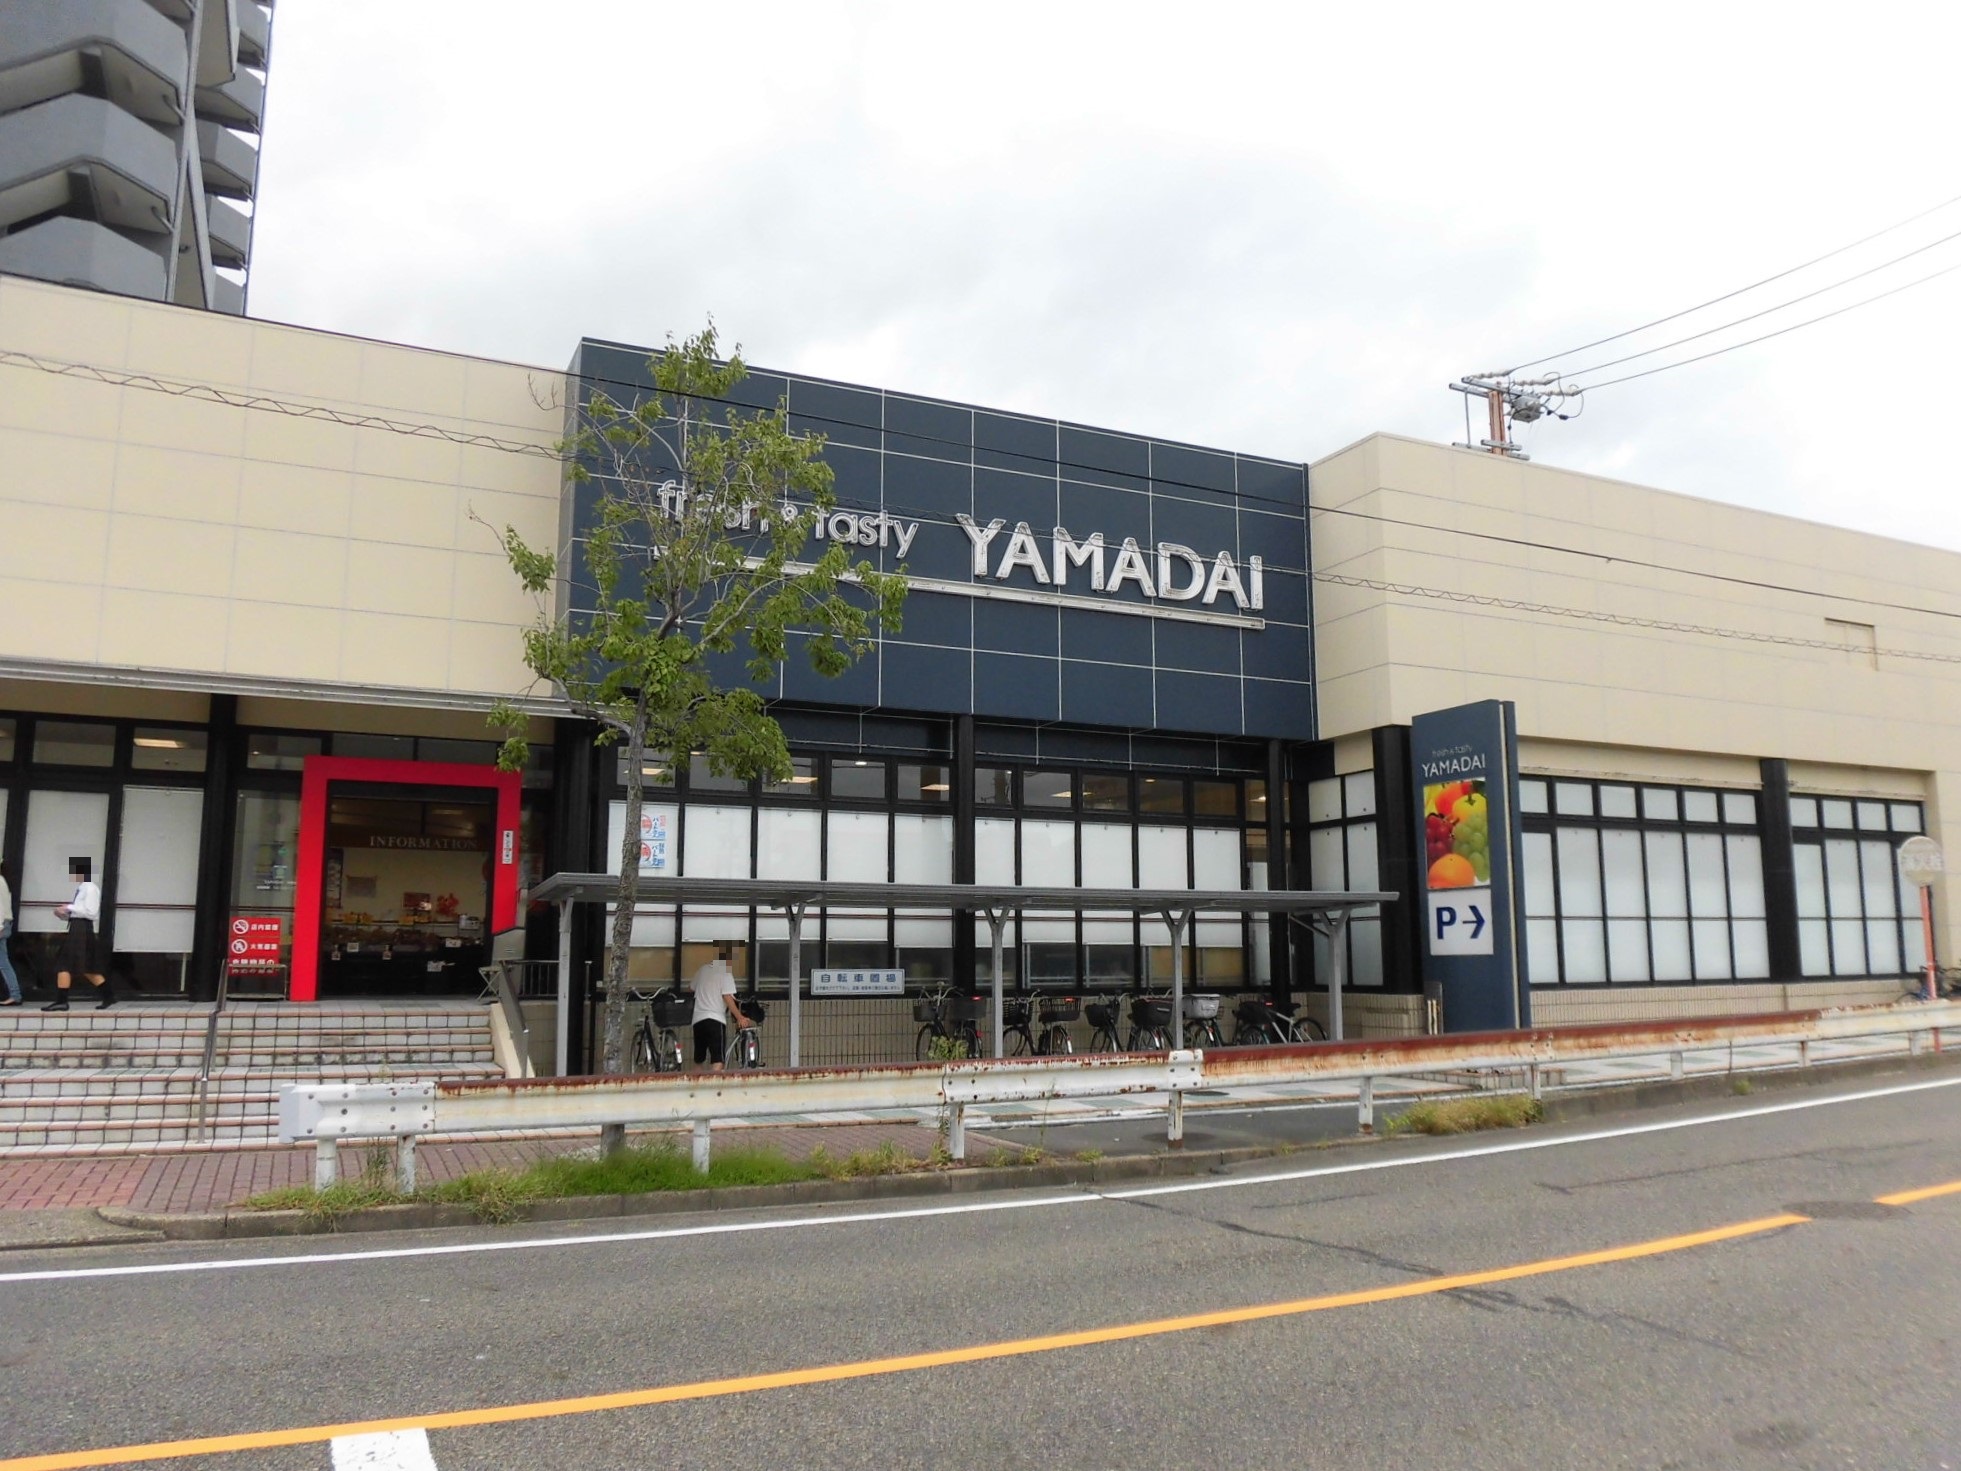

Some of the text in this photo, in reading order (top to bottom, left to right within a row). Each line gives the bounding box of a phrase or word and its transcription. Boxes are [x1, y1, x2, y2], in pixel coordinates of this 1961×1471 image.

[813, 505, 920, 559] tasty
[955, 512, 1264, 611] YAMADAI
[1421, 753, 1486, 778] YAMADAI
[369, 835, 477, 850] INFORMATION
[1436, 906, 1457, 940] P
[821, 973, 897, 983] 自転車置場
